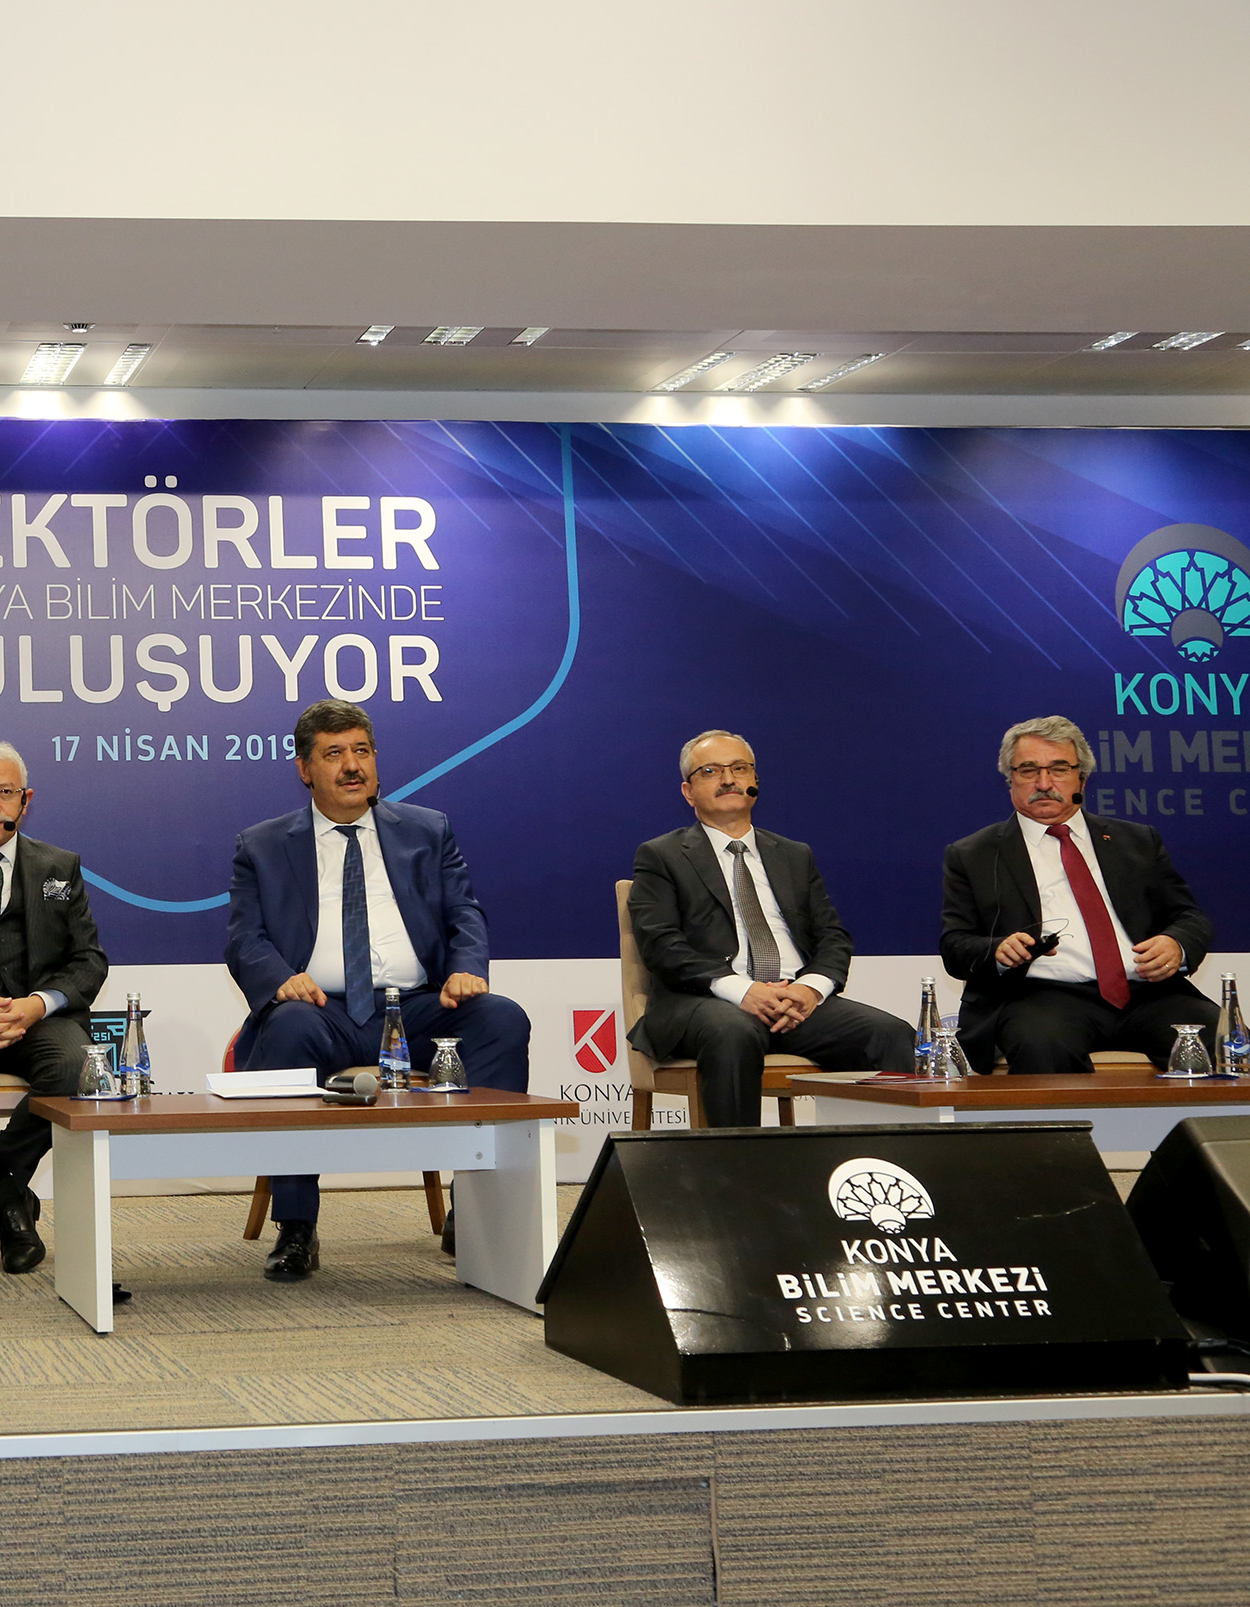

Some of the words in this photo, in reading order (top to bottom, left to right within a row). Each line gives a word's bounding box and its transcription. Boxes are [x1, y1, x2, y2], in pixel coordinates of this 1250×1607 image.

[46, 577, 156, 620] BİLİM
[172, 578, 445, 621] MERKEZİNDE
[51, 735, 81, 762] 17
[96, 727, 209, 762] NİSAN
[225, 734, 296, 761] 2019
[581, 1107, 687, 1125] ÜNİVEİTESİ
[841, 1237, 958, 1264] KONYA
[795, 1303, 926, 1323] SCIENCE
[937, 1299, 1052, 1319] CENTER
